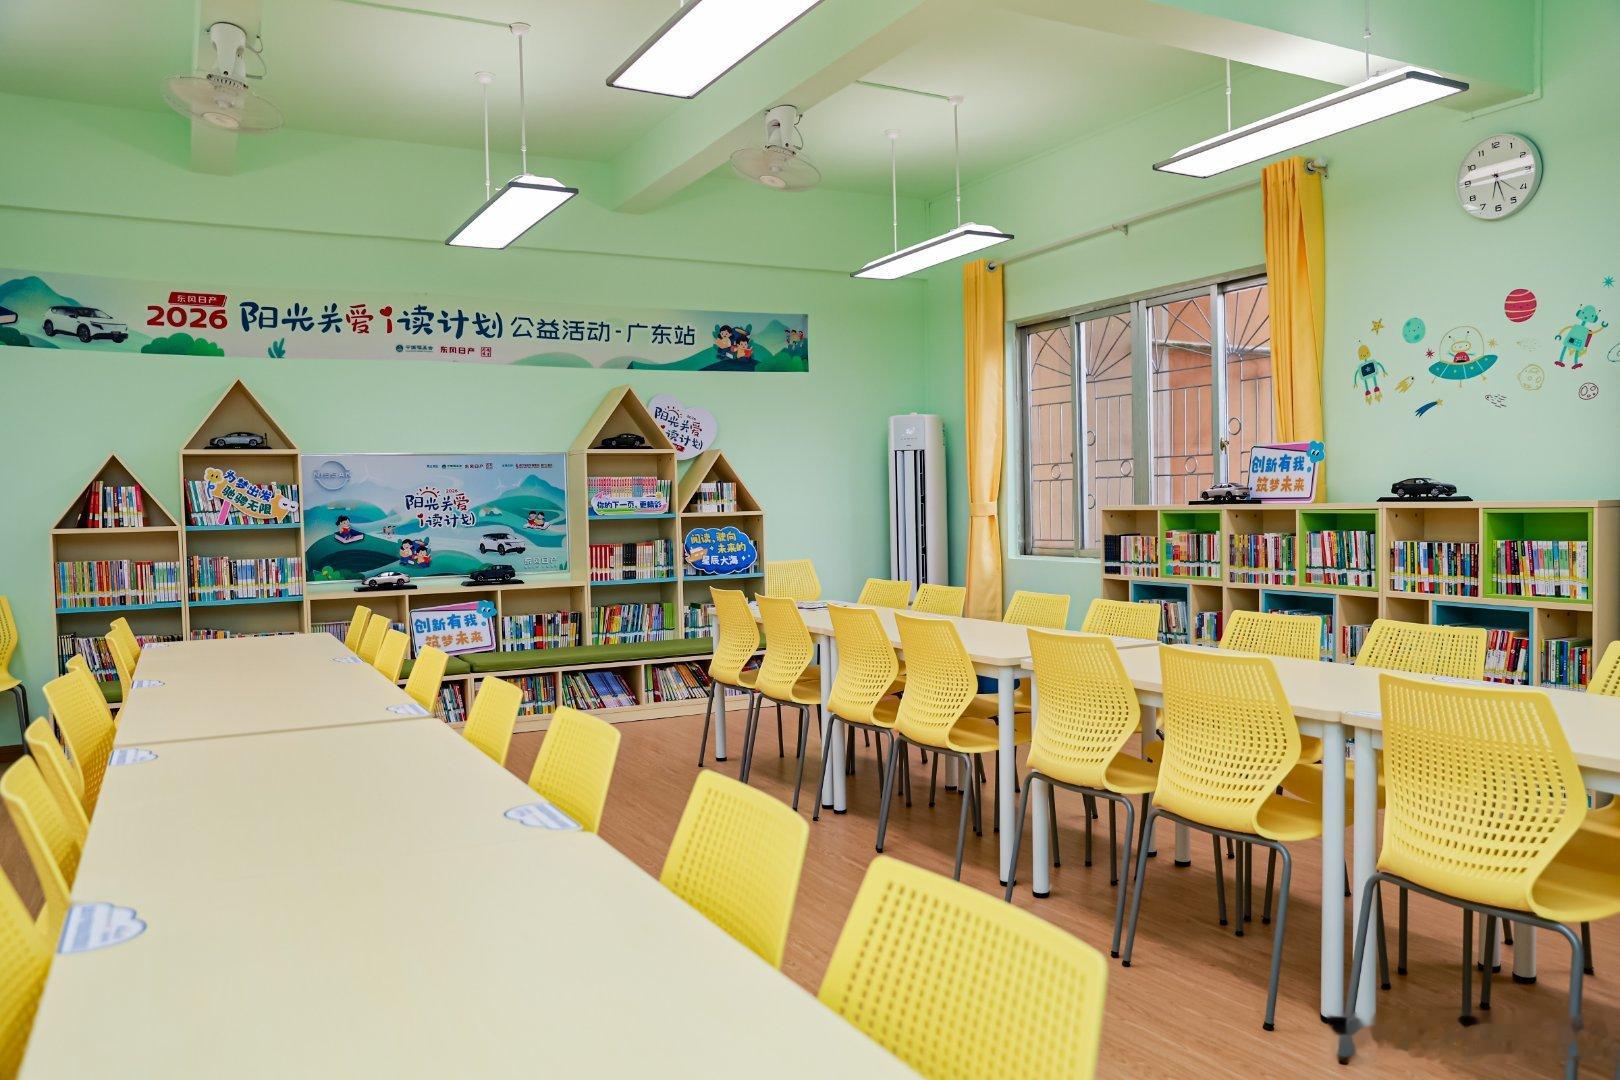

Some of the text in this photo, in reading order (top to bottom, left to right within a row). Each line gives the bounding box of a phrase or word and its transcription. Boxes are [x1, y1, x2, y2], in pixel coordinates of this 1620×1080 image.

[1491, 141, 1500, 149] 12
[1467, 164, 1477, 172] 10
[1464, 180, 1472, 188] 9
[1519, 182, 1527, 190] 4
[1469, 194, 1477, 202] 8
[1510, 196, 1518, 204] 5
[1480, 203, 1487, 211] 7
[1495, 204, 1502, 212] 6
[177, 295, 217, 304] 东风日产
[147, 305, 228, 330] 2026
[440, 346, 475, 355] 东风日产
[654, 406, 702, 437] 阳光关爱
[1255, 475, 1305, 492] 筑梦未来
[405, 493, 469, 511] 阳光关爱
[717, 541, 747, 554] 未来的
[701, 555, 739, 566] 星辰大海
[425, 630, 484, 648] 筑梦未来
